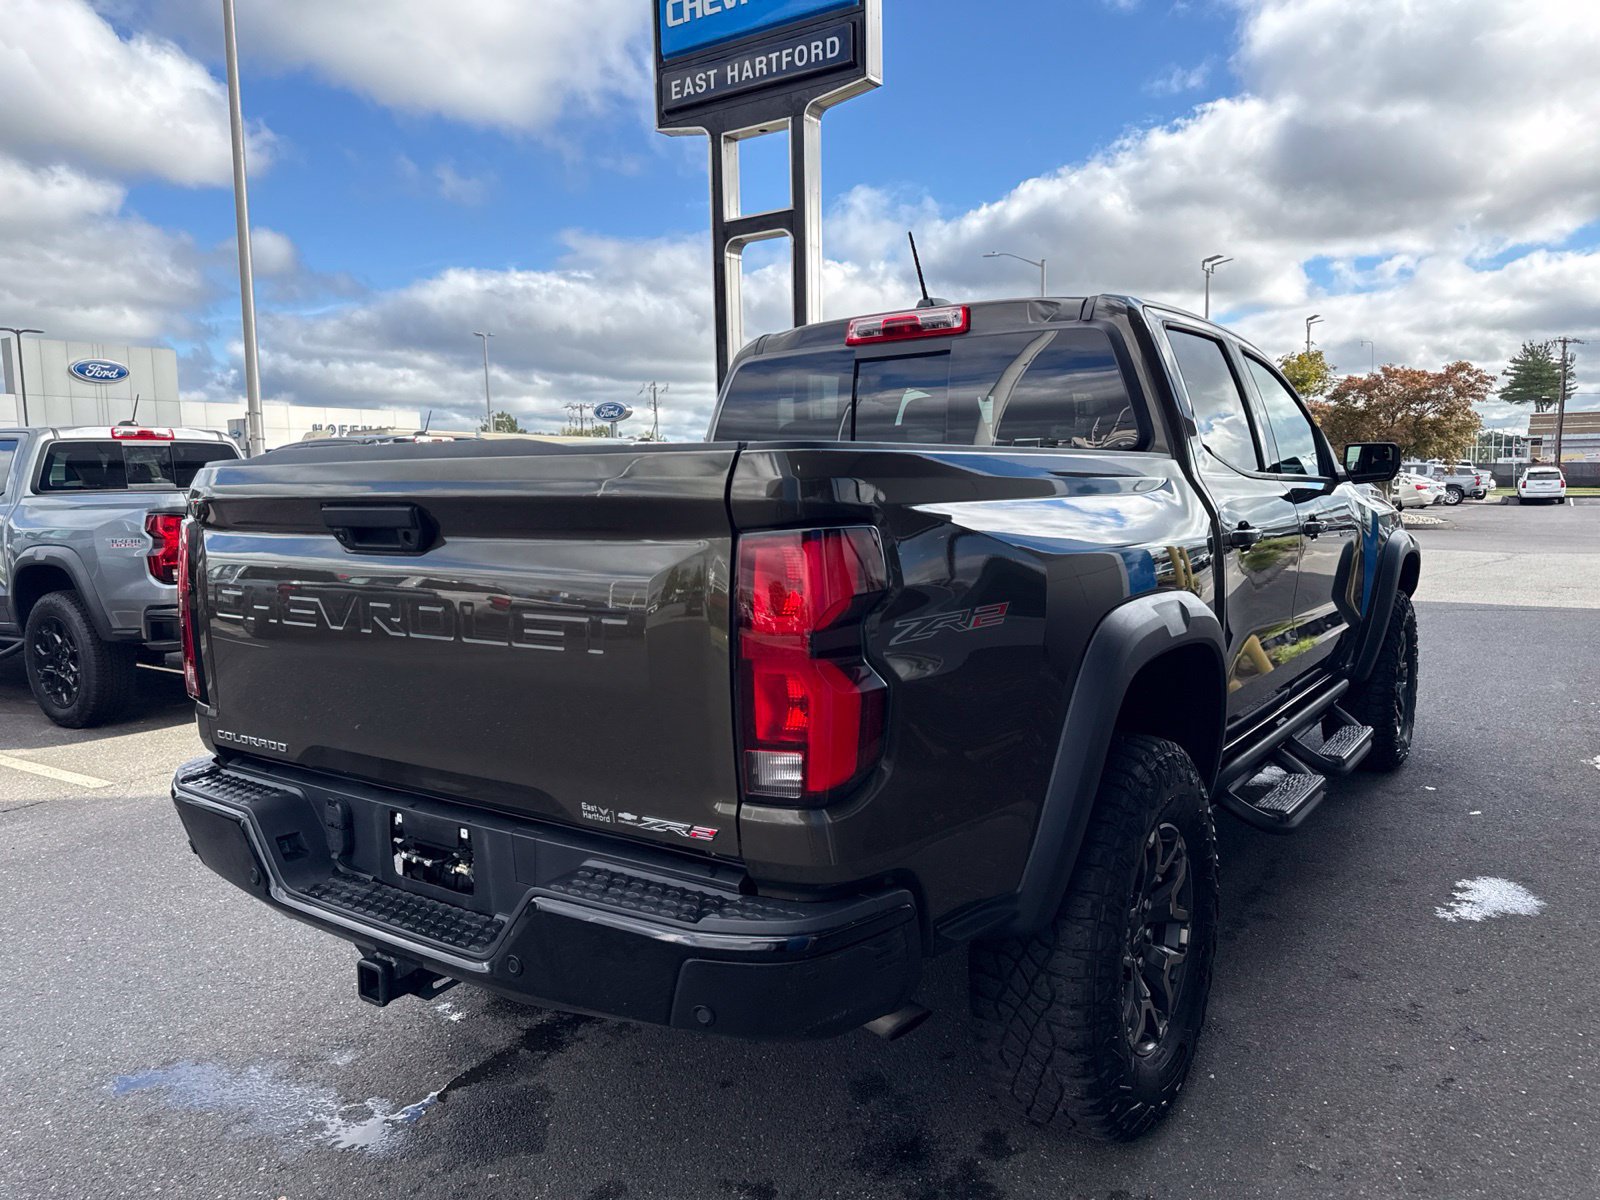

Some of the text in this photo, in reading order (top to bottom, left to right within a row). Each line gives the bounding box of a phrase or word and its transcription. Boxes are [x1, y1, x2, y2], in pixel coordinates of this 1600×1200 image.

[671, 36, 840, 100] EAST HARTFORD
[85, 363, 118, 378] Ford
[600, 405, 619, 418] Ford
[215, 583, 629, 655] CHEVROLET
[889, 602, 1009, 646] ZR2
[217, 729, 287, 752] COLORADO
[581, 801, 598, 812] East
[582, 810, 611, 823] Hartford
[637, 816, 719, 841] ZR2
